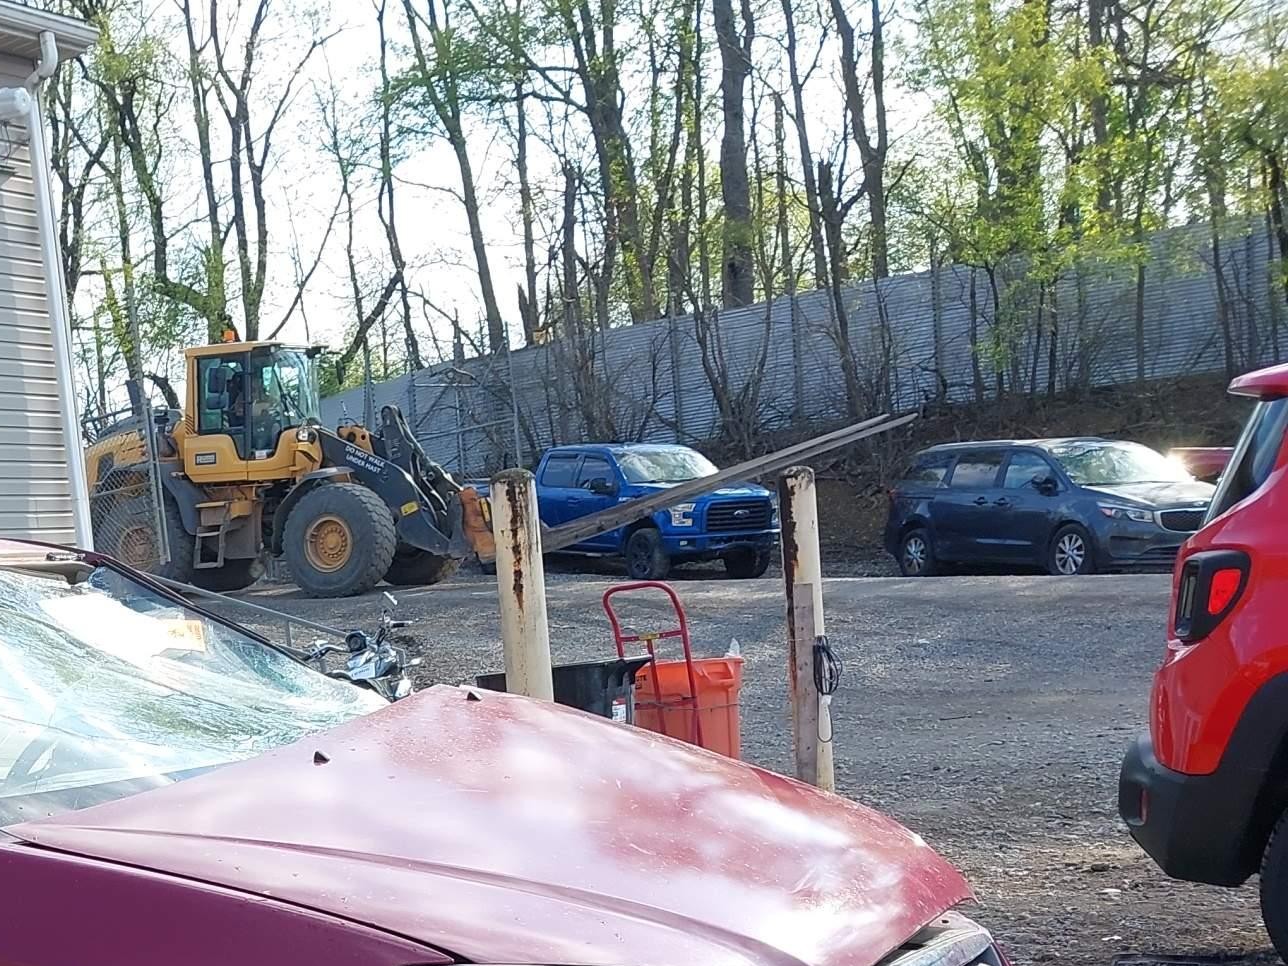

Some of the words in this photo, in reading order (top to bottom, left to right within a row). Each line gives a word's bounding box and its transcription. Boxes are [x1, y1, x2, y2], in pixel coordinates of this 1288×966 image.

[345, 445, 355, 454] DO
[355, 450, 368, 460] NOT
[368, 456, 385, 468] WALK
[346, 454, 365, 466] UNDER
